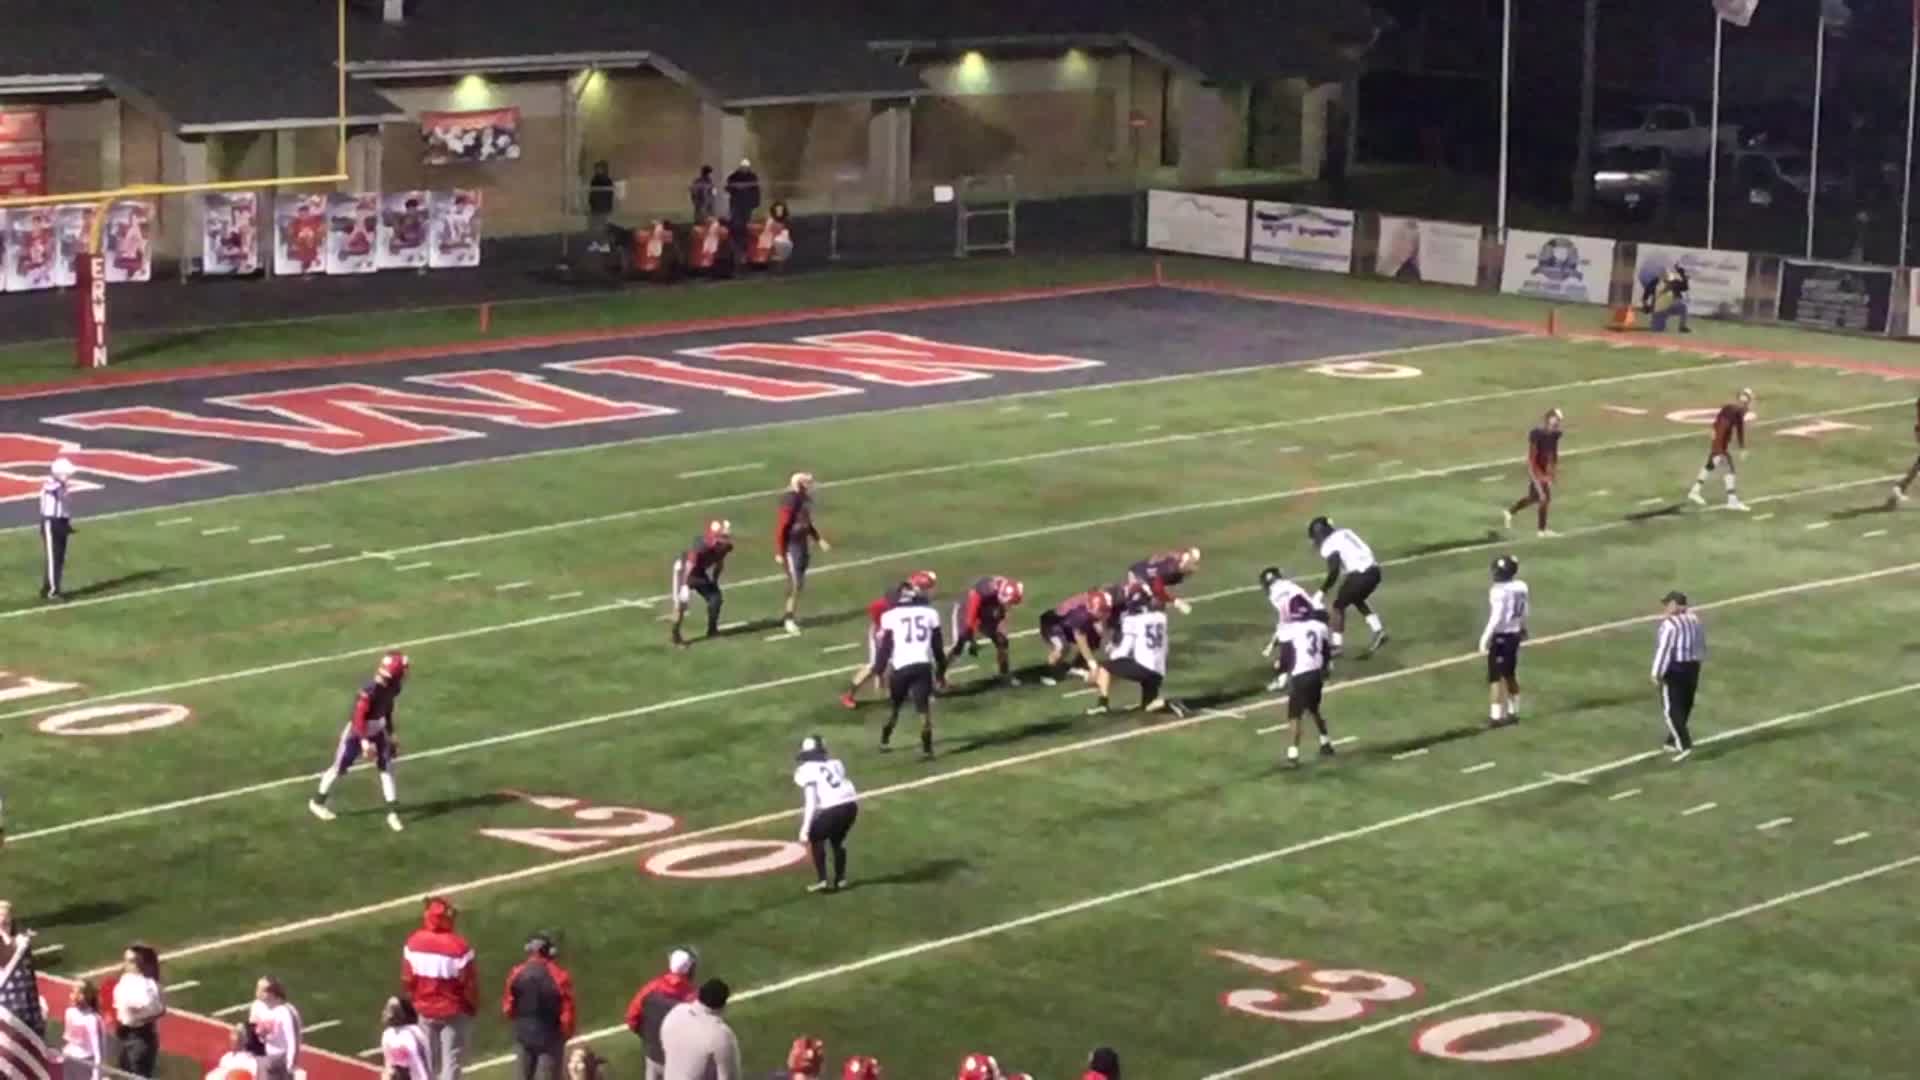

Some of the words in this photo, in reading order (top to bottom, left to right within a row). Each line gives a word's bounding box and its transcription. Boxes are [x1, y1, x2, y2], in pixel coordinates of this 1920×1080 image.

[91, 256, 108, 368] ERWIN
[900, 615, 929, 644] 75
[476, 804, 810, 880] 20
[1224, 967, 1596, 1062] 30
